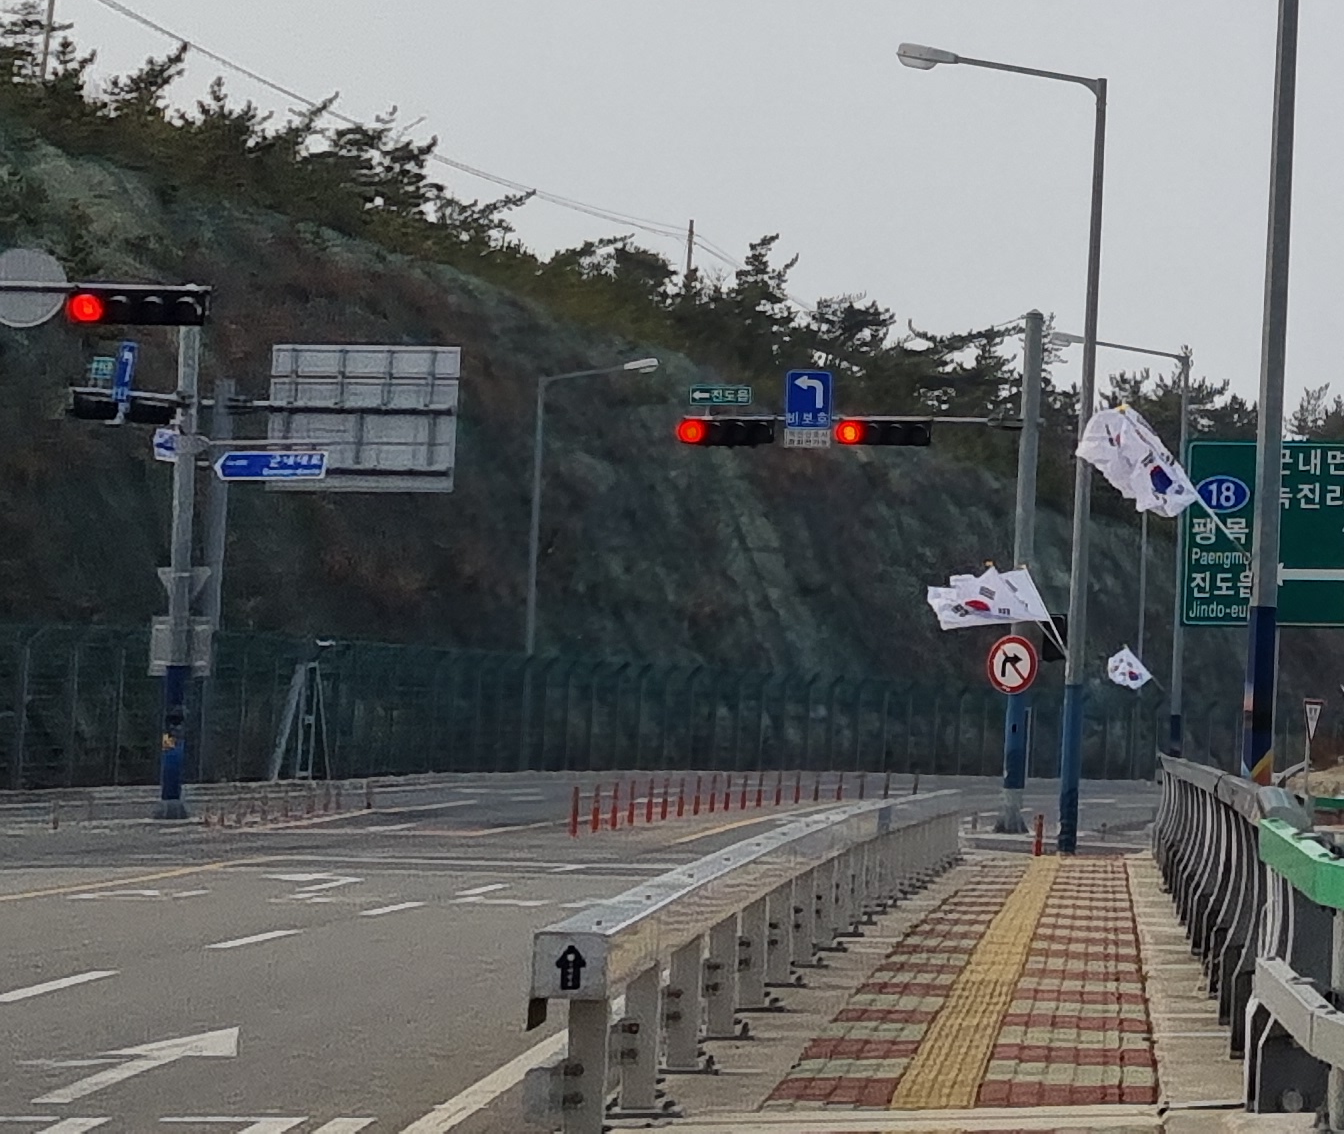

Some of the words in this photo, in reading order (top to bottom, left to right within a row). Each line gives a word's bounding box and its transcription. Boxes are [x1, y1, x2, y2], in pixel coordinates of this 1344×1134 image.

[711, 389, 750, 403] 진도읍
[787, 411, 828, 425] 비보호
[1208, 482, 1236, 507] 18
[1192, 548, 1251, 568] Paengmo
[1190, 569, 1252, 598] 진도읍
[1189, 601, 1250, 618] Jindo-eu
